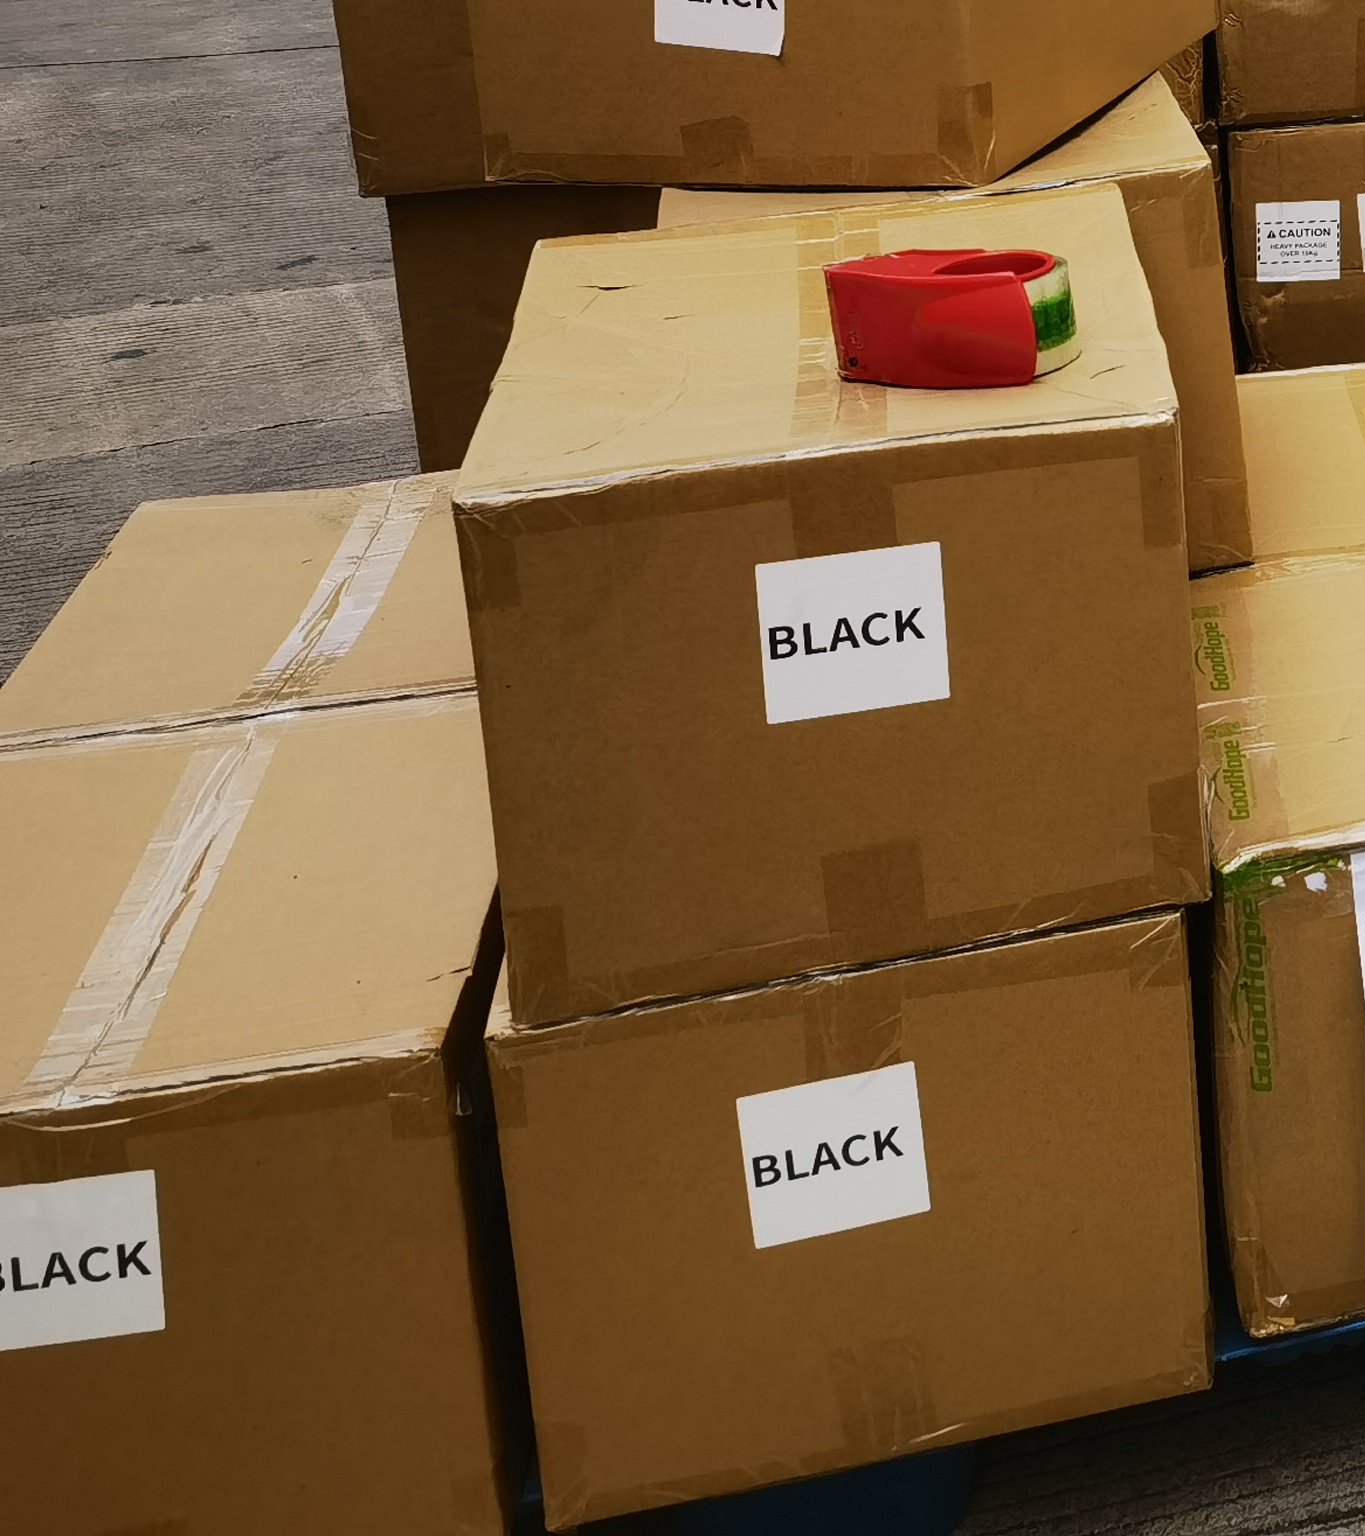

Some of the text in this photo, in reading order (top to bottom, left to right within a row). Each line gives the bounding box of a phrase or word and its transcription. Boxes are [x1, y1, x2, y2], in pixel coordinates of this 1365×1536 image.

[1279, 227, 1331, 239] CAUTION
[768, 606, 926, 661] BLACK
[1203, 621, 1230, 692] GoodHope
[1223, 739, 1251, 822] GoodHope
[752, 1125, 905, 1189] BLACK
[0, 1240, 152, 1294] LACK
